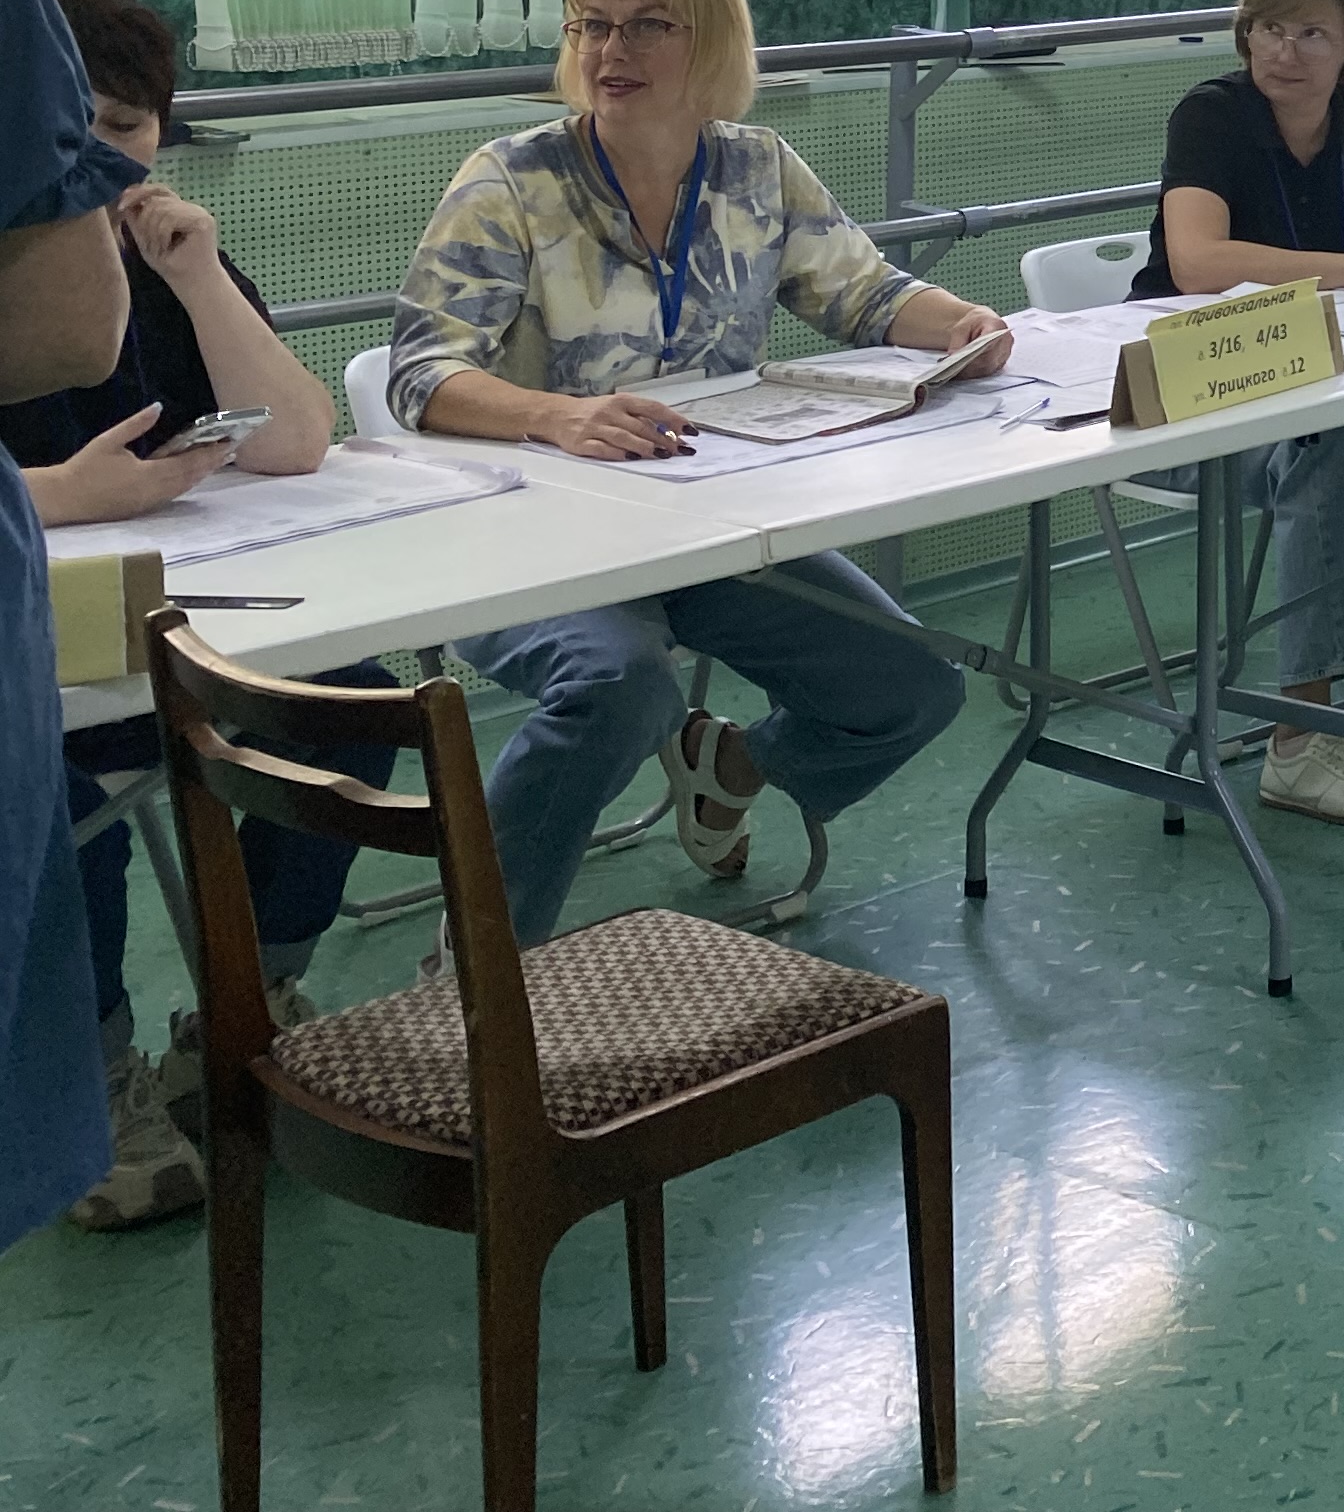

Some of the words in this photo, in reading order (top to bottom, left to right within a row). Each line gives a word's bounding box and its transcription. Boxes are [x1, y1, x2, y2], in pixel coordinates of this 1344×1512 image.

[1185, 289, 1296, 327] Привокзальная
[1256, 323, 1288, 348] 4/43
[1207, 368, 1276, 399] Урицкого
